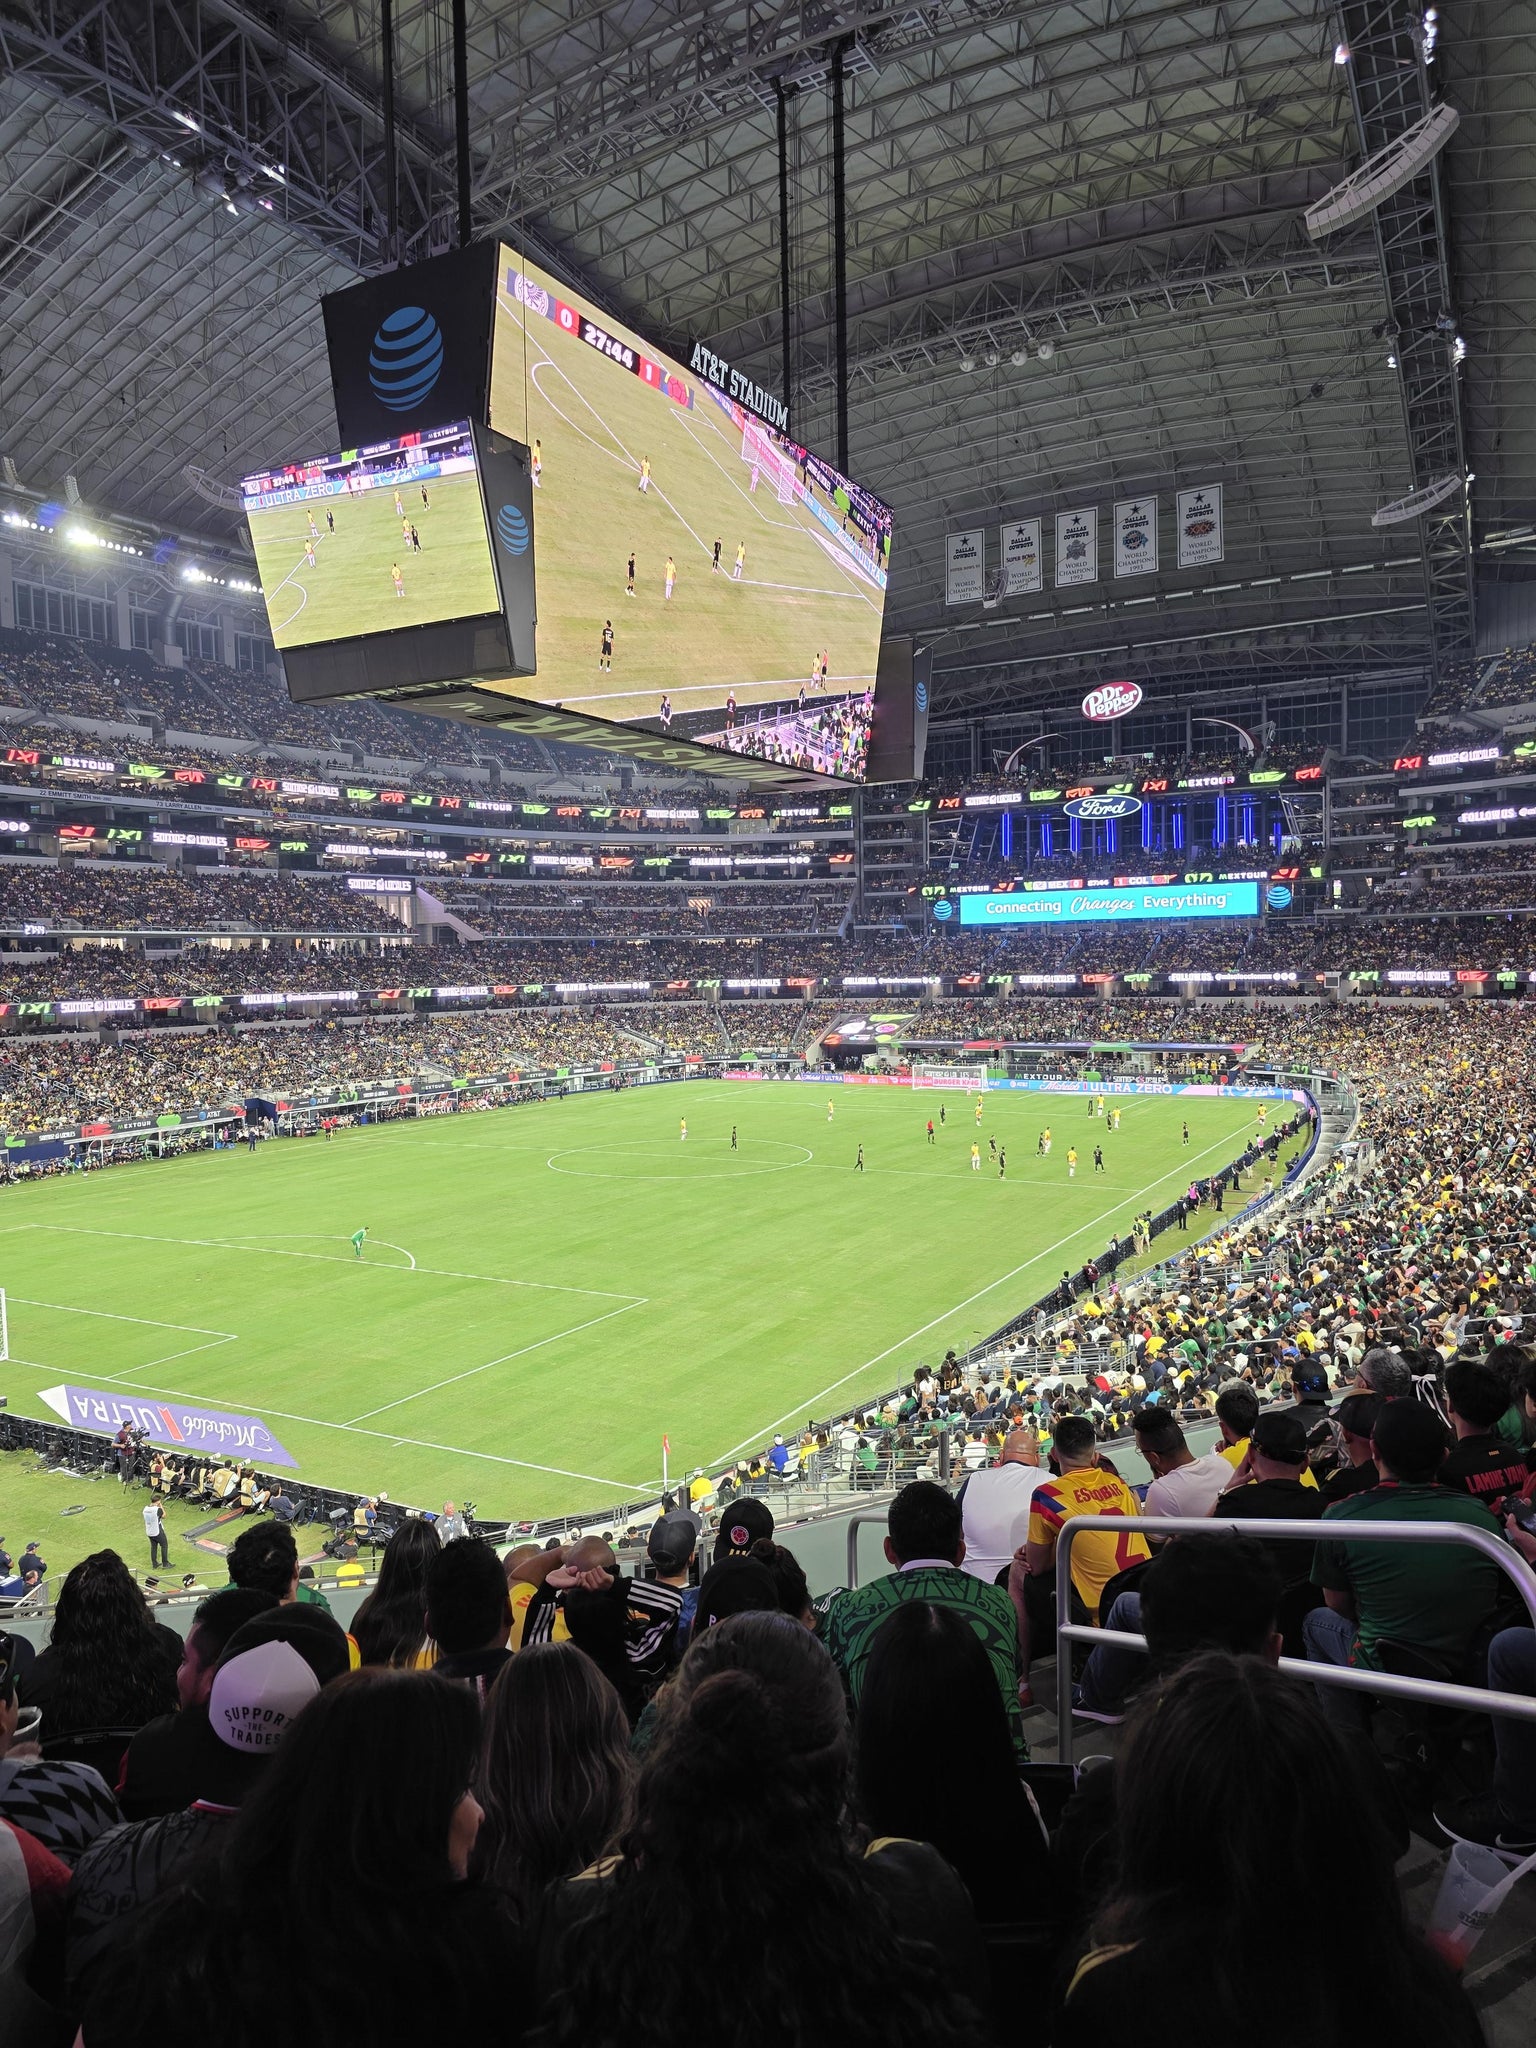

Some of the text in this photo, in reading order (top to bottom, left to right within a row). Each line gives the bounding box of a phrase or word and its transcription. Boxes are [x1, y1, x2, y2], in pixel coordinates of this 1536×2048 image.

[560, 308, 573, 329] 0
[584, 324, 634, 369] 27:44
[645, 364, 653, 381] 1
[690, 342, 789, 432] AT&T STADIUM
[265, 489, 300, 506] ULTRA
[303, 482, 334, 498] ZERO
[1188, 503, 1211, 513] DALLAS
[1125, 514, 1147, 524] DALLAS
[1186, 509, 1214, 519] COWBOYS
[1065, 525, 1087, 534] DALLAS
[1122, 520, 1149, 530] COWBOYS
[1011, 536, 1031, 545] DALLAS
[1063, 531, 1089, 540] COWBOYS
[1008, 542, 1033, 551] COWBOYS
[1188, 540, 1213, 549] WORLD
[955, 546, 975, 554] DALLAS
[1124, 550, 1148, 560] WORLD
[1181, 545, 1220, 558] CHAMPIONS
[953, 551, 977, 560] COWBOYS
[1065, 561, 1088, 569] WORLD
[1117, 556, 1155, 568] CHAMPIONS
[1011, 570, 1033, 578] WORLD
[1059, 567, 1094, 577] CHAMPIONS
[954, 580, 976, 588] WORLD
[1008, 576, 1039, 586] HAMPIONS
[949, 586, 982, 595] CHAMPIONS
[1102, 686, 1124, 702] Dr
[1084, 690, 1138, 718] Pepper
[52, 757, 115, 771] MEXTOUR
[1178, 776, 1235, 788] MEXTOUR
[468, 801, 512, 811] MEXTOUR
[1079, 798, 1126, 816] Ford
[772, 808, 819, 816] MEXTOUR
[1462, 810, 1499, 822] FOLLOW
[1219, 871, 1267, 880] MEXTOUR
[1048, 880, 1068, 889] MEX
[1129, 877, 1149, 885] COL
[950, 885, 989, 893] MEXTOUR
[986, 893, 1227, 915] Connecting Changes Everything
[825, 1074, 843, 1082] ULTRA
[962, 1079, 979, 1087] KING
[1090, 1082, 1131, 1093] ULTRA
[1136, 1083, 1172, 1094] ZERO
[206, 1110, 221, 1119] AT&T
[117, 1121, 151, 1131] MEXTOUR
[73, 1396, 273, 1452] Michelob ULTRA
[1465, 1469, 1506, 1494] LAMINE
[224, 1706, 295, 1729] SUPPORT
[231, 1726, 281, 1745] TRADES
